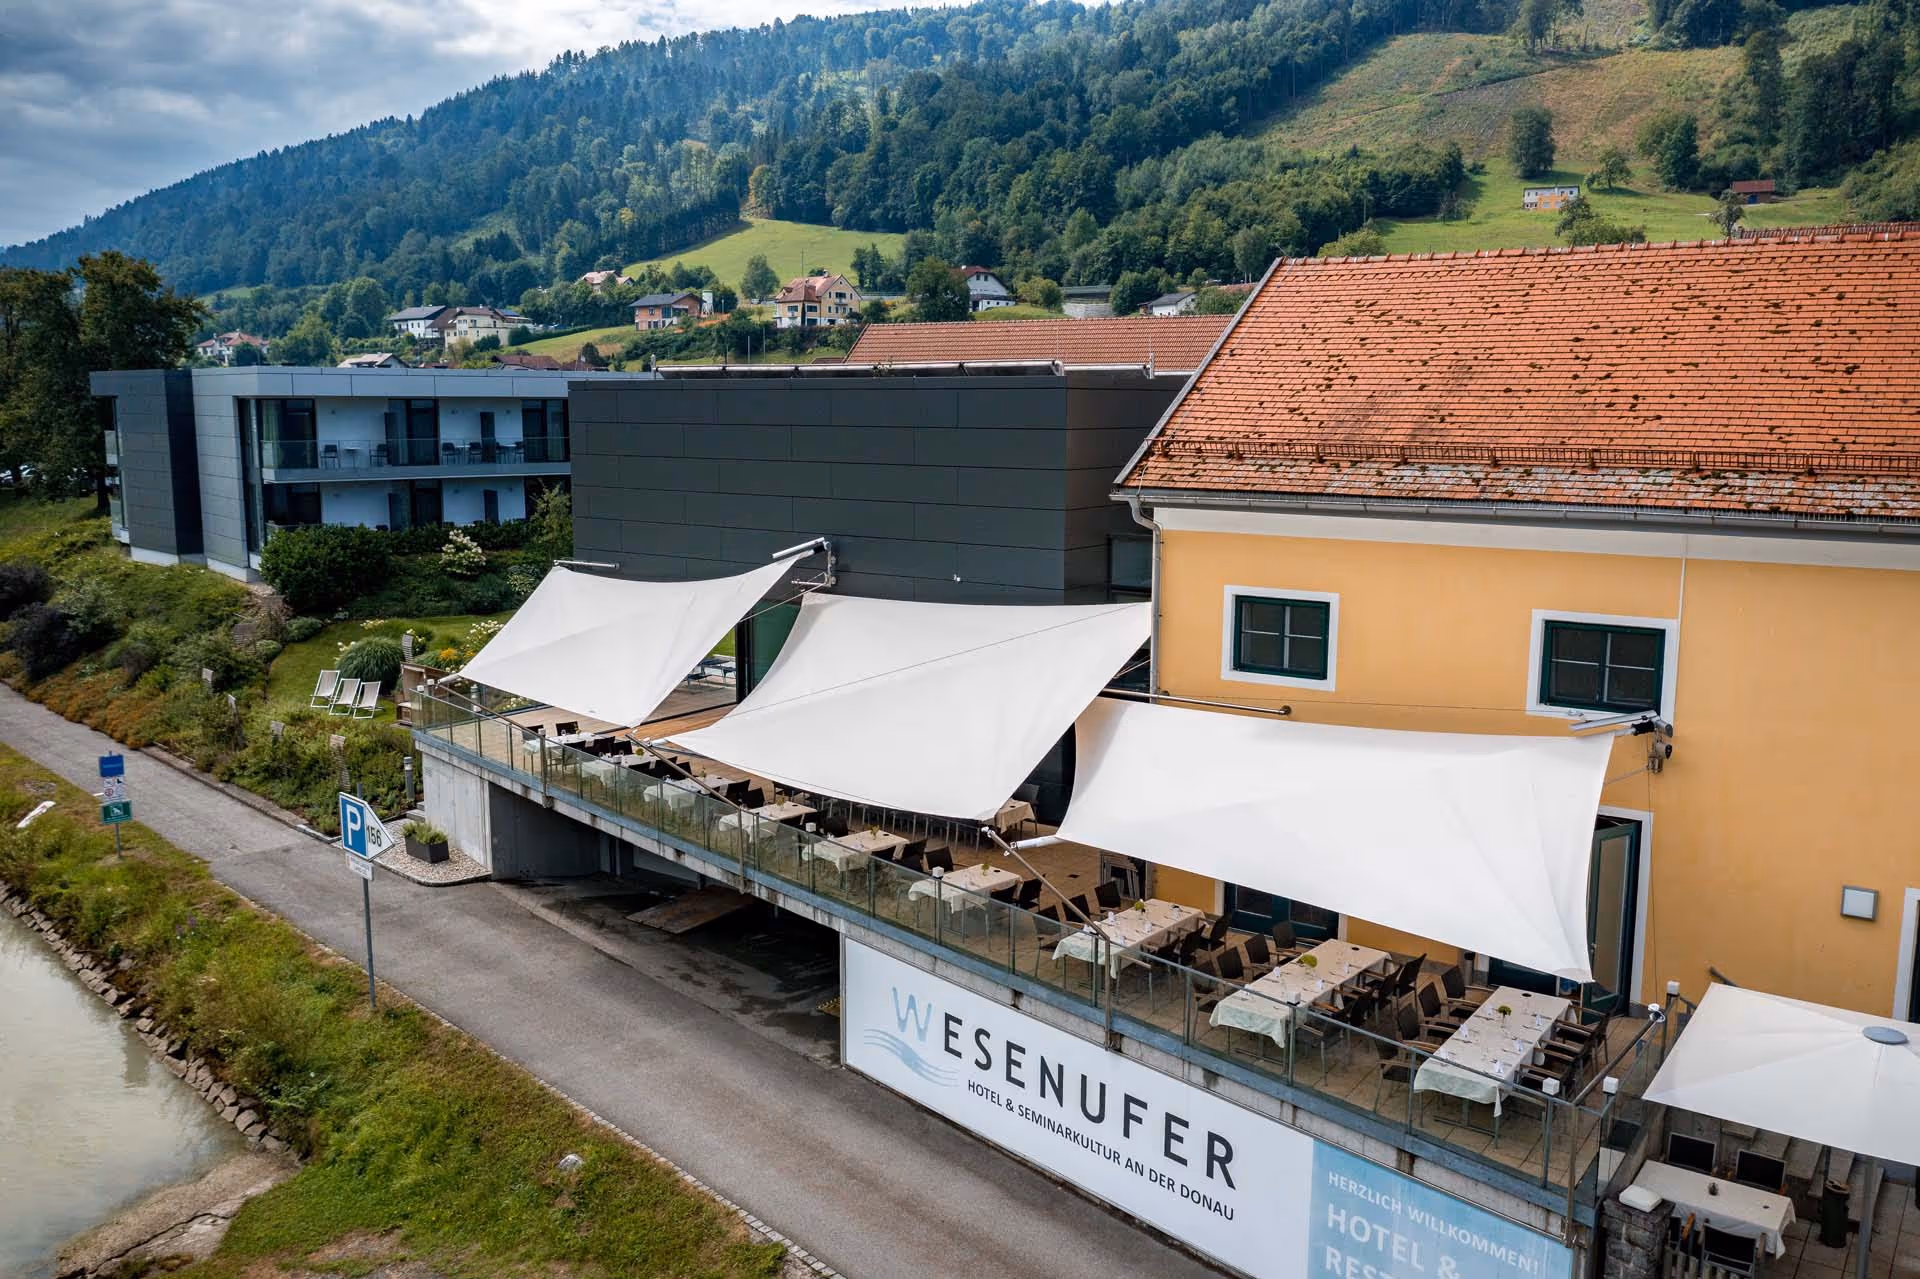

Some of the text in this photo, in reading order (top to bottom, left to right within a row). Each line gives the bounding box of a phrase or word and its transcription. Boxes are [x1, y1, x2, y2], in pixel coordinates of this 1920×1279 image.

[346, 804, 361, 846] P
[366, 825, 382, 847] 156
[892, 986, 1237, 1190] WESENUFER
[967, 1079, 1234, 1221] HOTEL & SEMINARKULTUR AN DER DONAU
[1327, 1203, 1461, 1279] HOTEL &
[1328, 1171, 1539, 1275] HERZLICH WILLKOMMEN!
